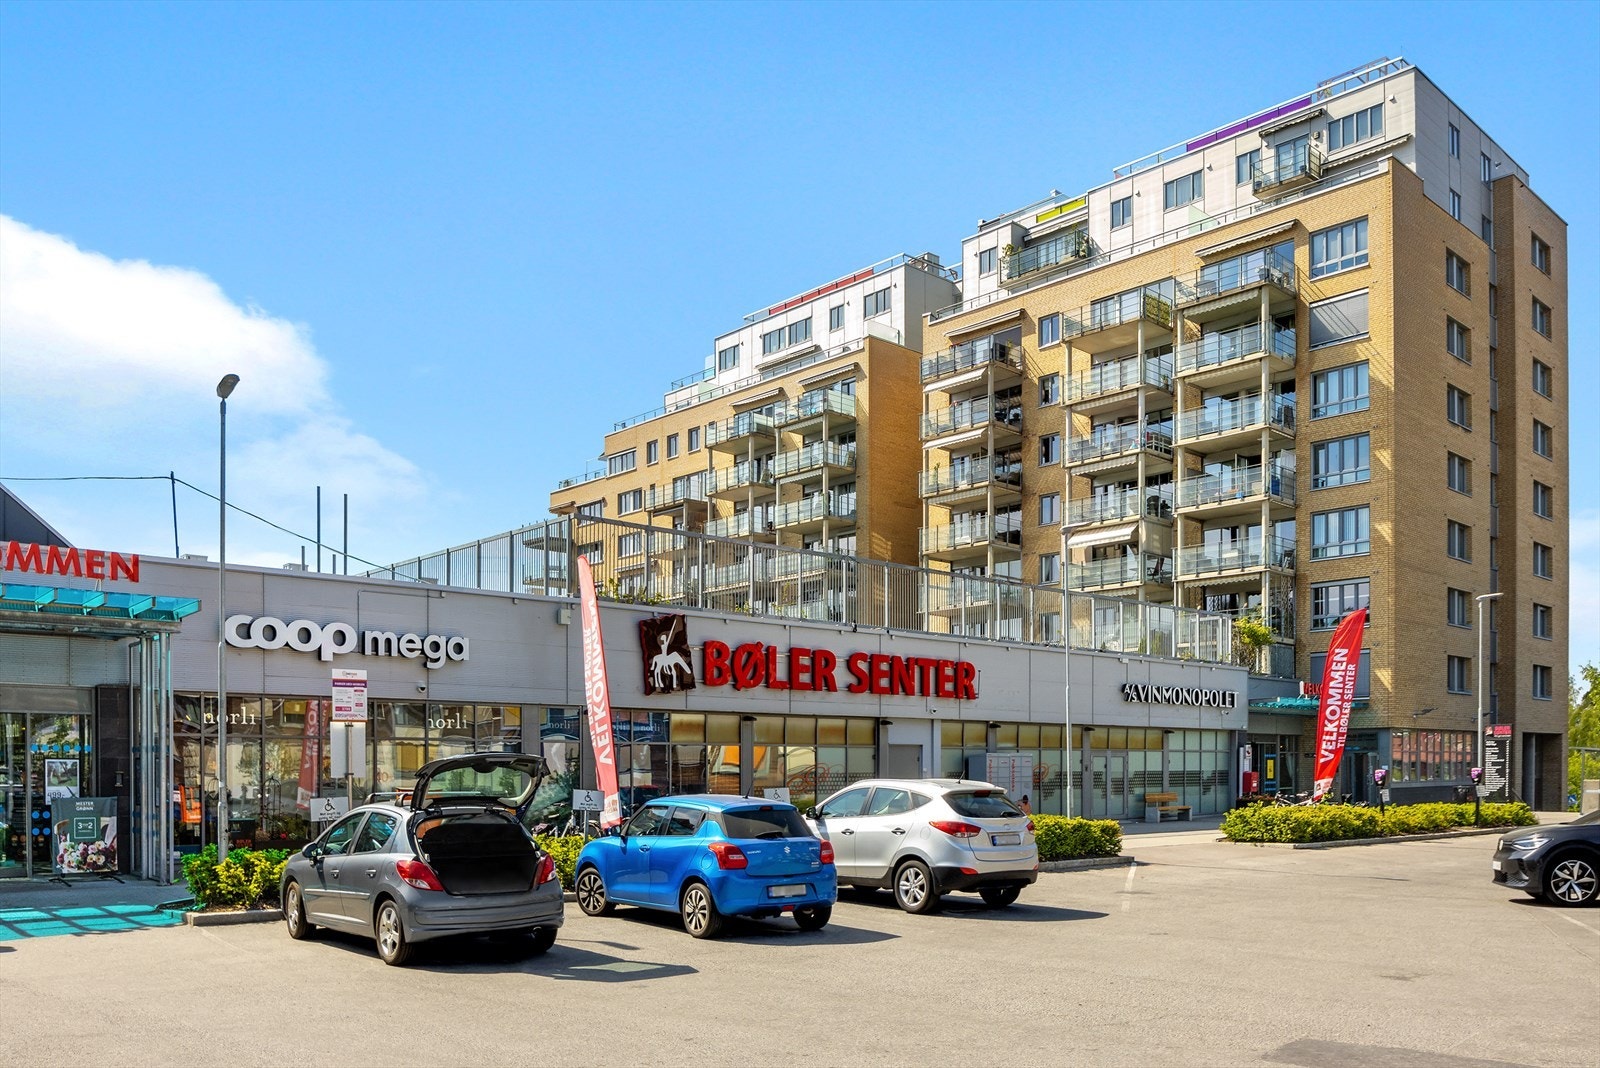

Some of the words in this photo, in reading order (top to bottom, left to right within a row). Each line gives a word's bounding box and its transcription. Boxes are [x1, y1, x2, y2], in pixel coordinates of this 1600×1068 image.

[0, 541, 139, 582] MMEN
[225, 615, 358, 661] coop
[364, 630, 469, 669] mega
[703, 640, 838, 691] BØLER
[848, 652, 976, 701] SENTER
[1344, 663, 1356, 700] SENTER
[1138, 684, 1239, 708] VINMONOPOLET
[1303, 683, 1323, 696] VELK
[1319, 648, 1348, 764] VELKOMMEN
[1339, 701, 1352, 733] BØLER
[1337, 734, 1347, 749] TIL
